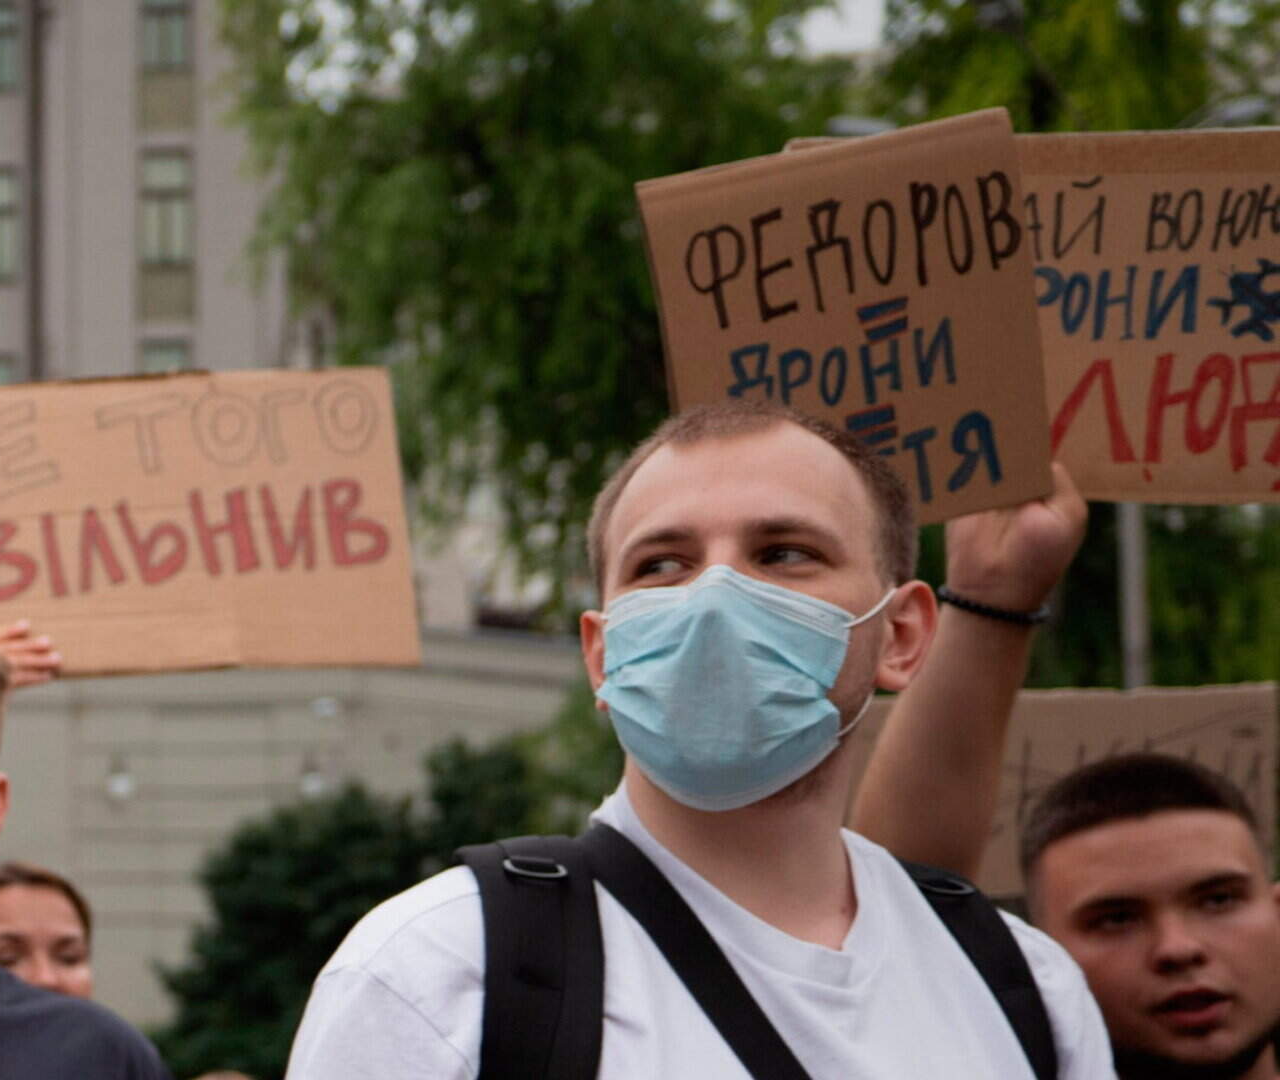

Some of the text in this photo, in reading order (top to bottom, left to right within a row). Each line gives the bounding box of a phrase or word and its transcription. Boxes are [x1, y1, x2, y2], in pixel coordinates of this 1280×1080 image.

[685, 170, 1024, 329] ФЕДОРОВ
[726, 317, 957, 406] ДРОНИ
[96, 378, 380, 477] ТОГО
[880, 411, 1003, 503] ТЯ
